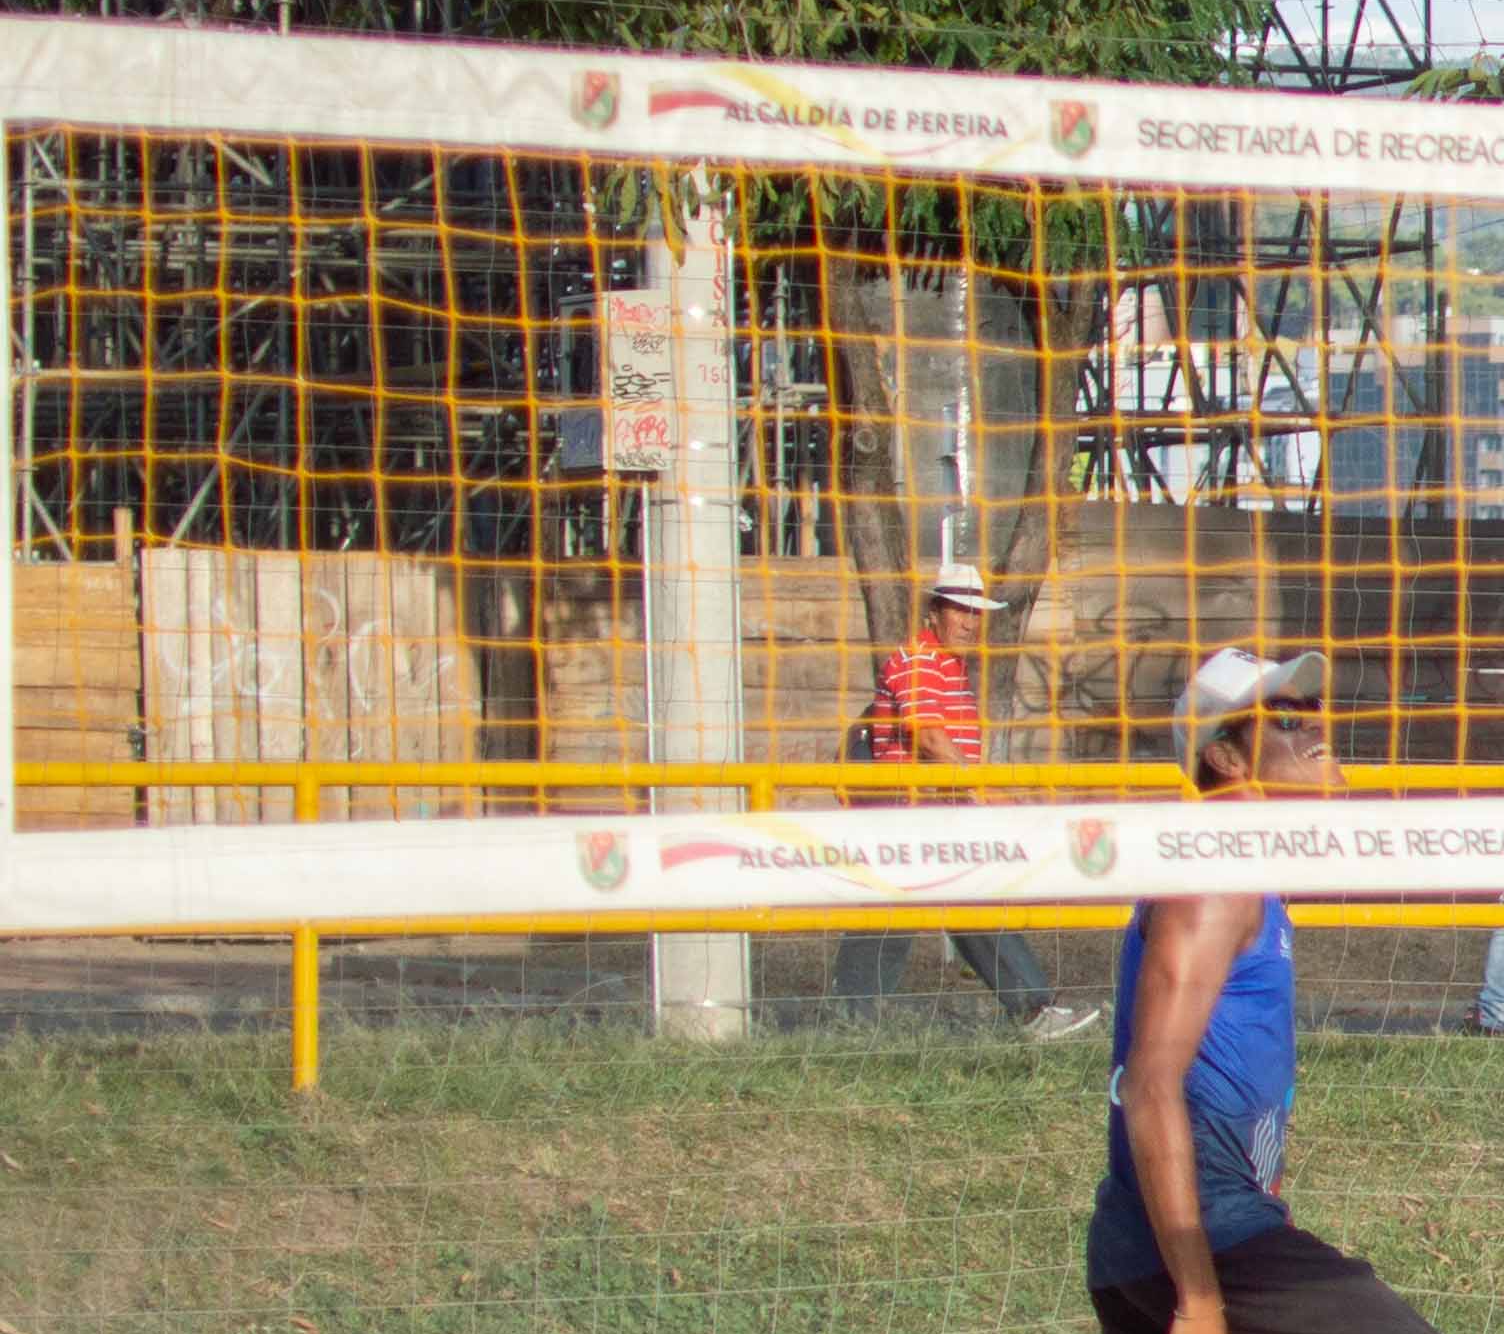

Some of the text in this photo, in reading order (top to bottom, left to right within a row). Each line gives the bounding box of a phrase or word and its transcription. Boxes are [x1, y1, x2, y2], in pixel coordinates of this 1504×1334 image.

[724, 97, 1009, 139] ALCALDÍA DE PEREIRA
[1138, 117, 1320, 158] SECRETARÍA
[1335, 130, 1370, 160] DE
[739, 836, 1030, 869] ALCALDÍA DE PEREIRA
[1157, 823, 1345, 860] SECRETARÍA
[1355, 829, 1394, 857] DE
